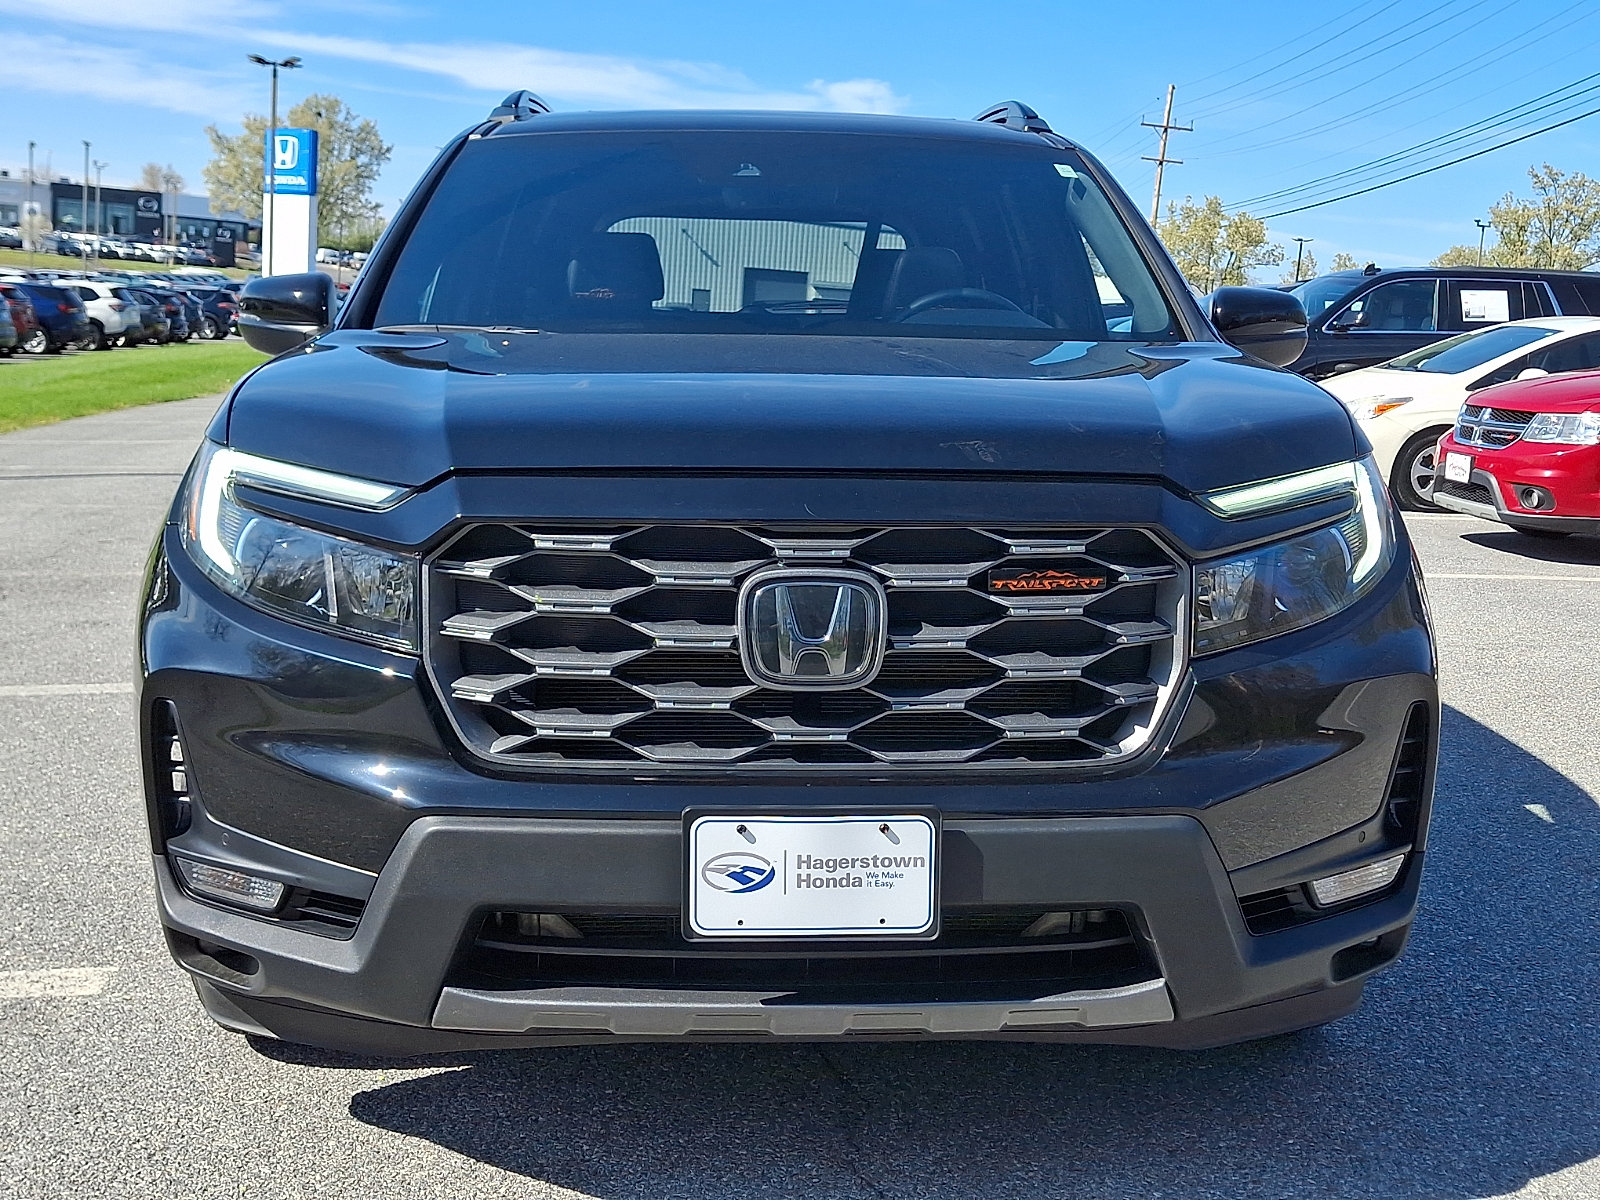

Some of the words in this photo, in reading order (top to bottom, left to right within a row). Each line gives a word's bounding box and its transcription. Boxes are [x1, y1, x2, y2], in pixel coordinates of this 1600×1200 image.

[992, 578, 1104, 590] TRAILSPORT
[796, 854, 926, 873] Hagerstown
[796, 872, 863, 888] Honda
[865, 871, 880, 879] We
[881, 871, 904, 879] Make
[866, 880, 873, 888] it
[874, 880, 895, 889] Easy.
